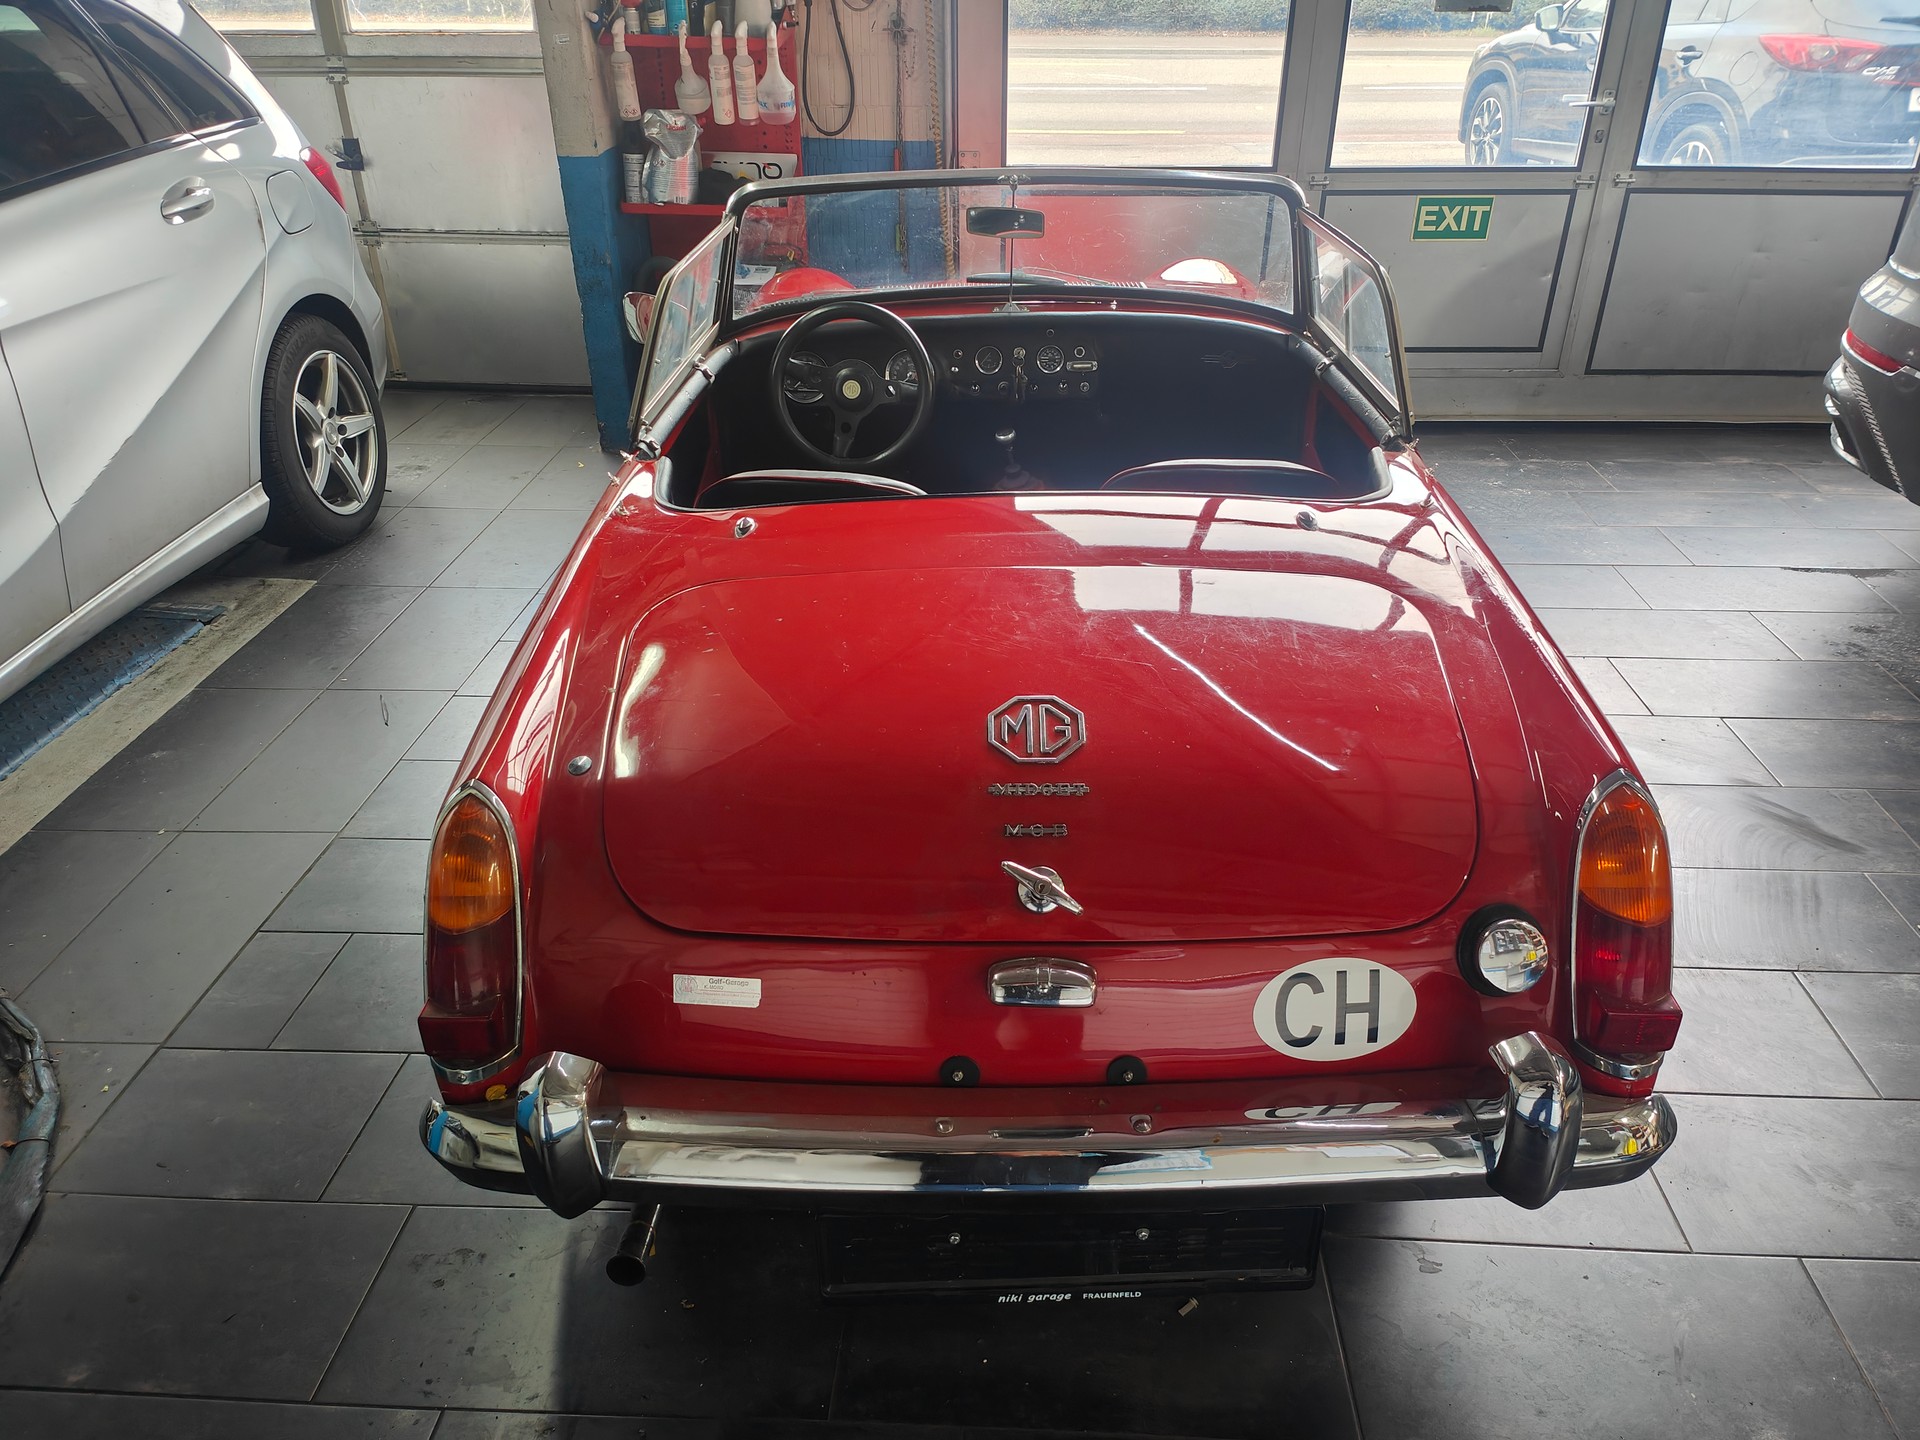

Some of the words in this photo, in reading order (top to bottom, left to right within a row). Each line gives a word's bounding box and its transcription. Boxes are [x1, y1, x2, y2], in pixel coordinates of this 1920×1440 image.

[1416, 204, 1491, 232] EXIT
[1001, 704, 1072, 753] MG
[990, 782, 1088, 796] MIDGET
[709, 978, 749, 987] Golf-Garage
[1275, 969, 1380, 1048] CH
[998, 1294, 1023, 1303] niki
[1027, 1293, 1072, 1303] garage
[1083, 1291, 1142, 1299] FRAUENFELD
